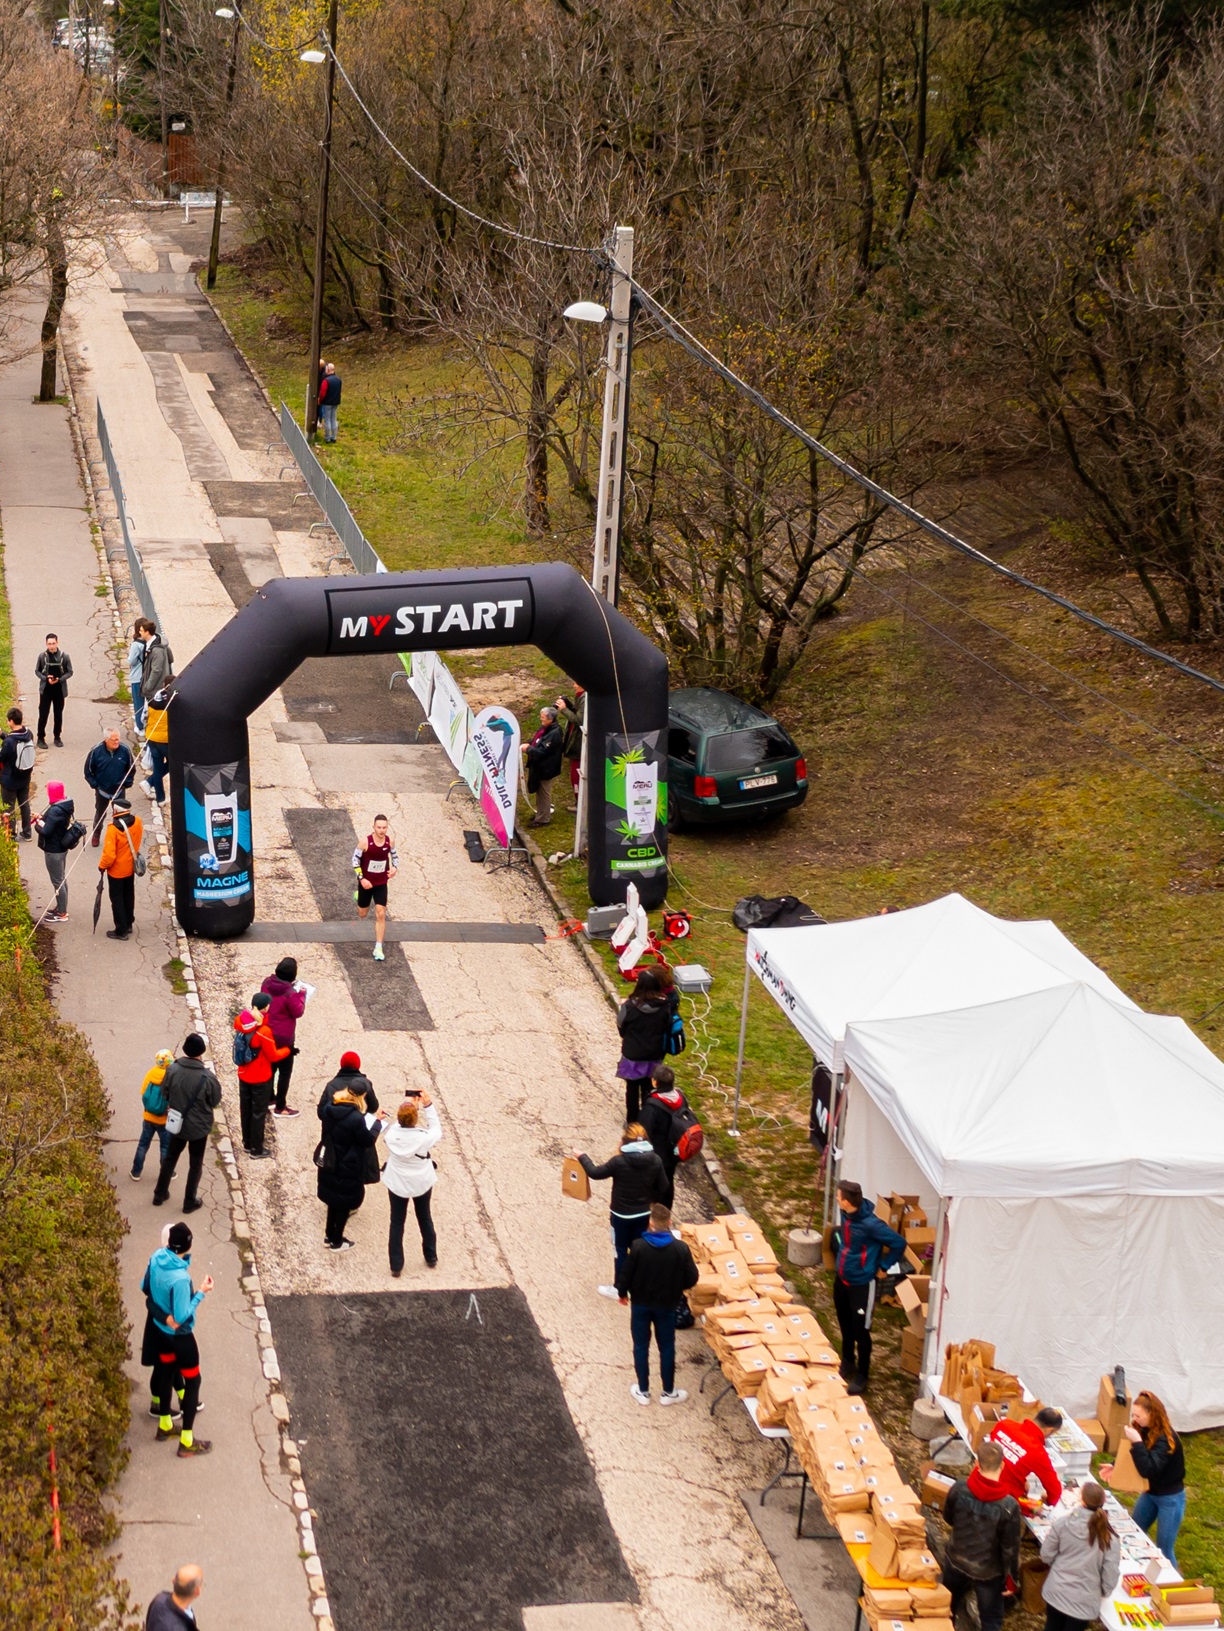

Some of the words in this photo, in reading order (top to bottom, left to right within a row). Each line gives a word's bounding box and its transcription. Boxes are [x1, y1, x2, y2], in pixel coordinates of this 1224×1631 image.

[394, 599, 524, 636] START
[627, 846, 656, 858] CBD
[197, 871, 249, 888] MAGNE
[196, 889, 233, 899] MAGNESIUM
